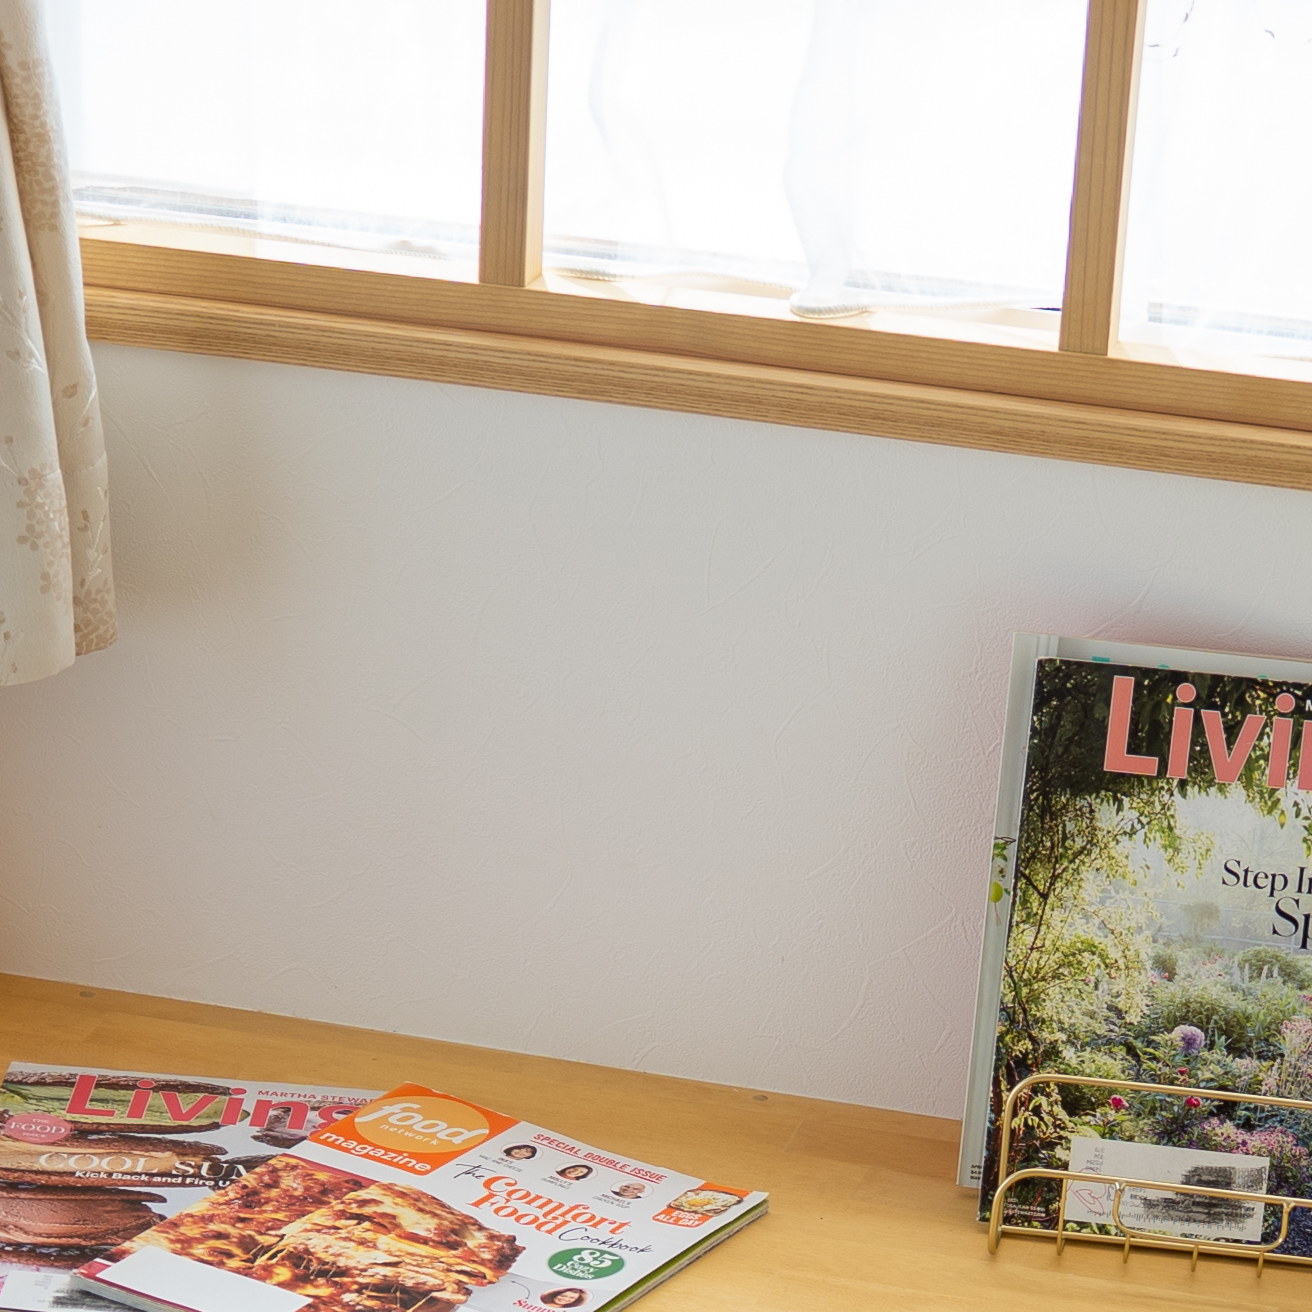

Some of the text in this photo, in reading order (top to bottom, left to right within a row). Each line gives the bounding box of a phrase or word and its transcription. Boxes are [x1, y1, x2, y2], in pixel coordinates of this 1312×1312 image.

[1221, 858, 1289, 898] Step
[257, 1090, 317, 1100] MARTHA
[10, 1121, 66, 1134] FOOD
[354, 1102, 490, 1144] food
[379, 1123, 440, 1146] network
[38, 1152, 159, 1174] COOL
[319, 1131, 432, 1172] magazine
[533, 1133, 668, 1182] SPECIAL DOUBLE ISSUE
[74, 1170, 108, 1179] Kick
[112, 1172, 149, 1182] Back
[152, 1175, 182, 1184] and
[187, 1177, 215, 1186] Fire
[454, 1163, 498, 1180] The
[482, 1175, 632, 1235] Comfort
[466, 1192, 654, 1254] Food Cookbook
[572, 1249, 621, 1268] 85
